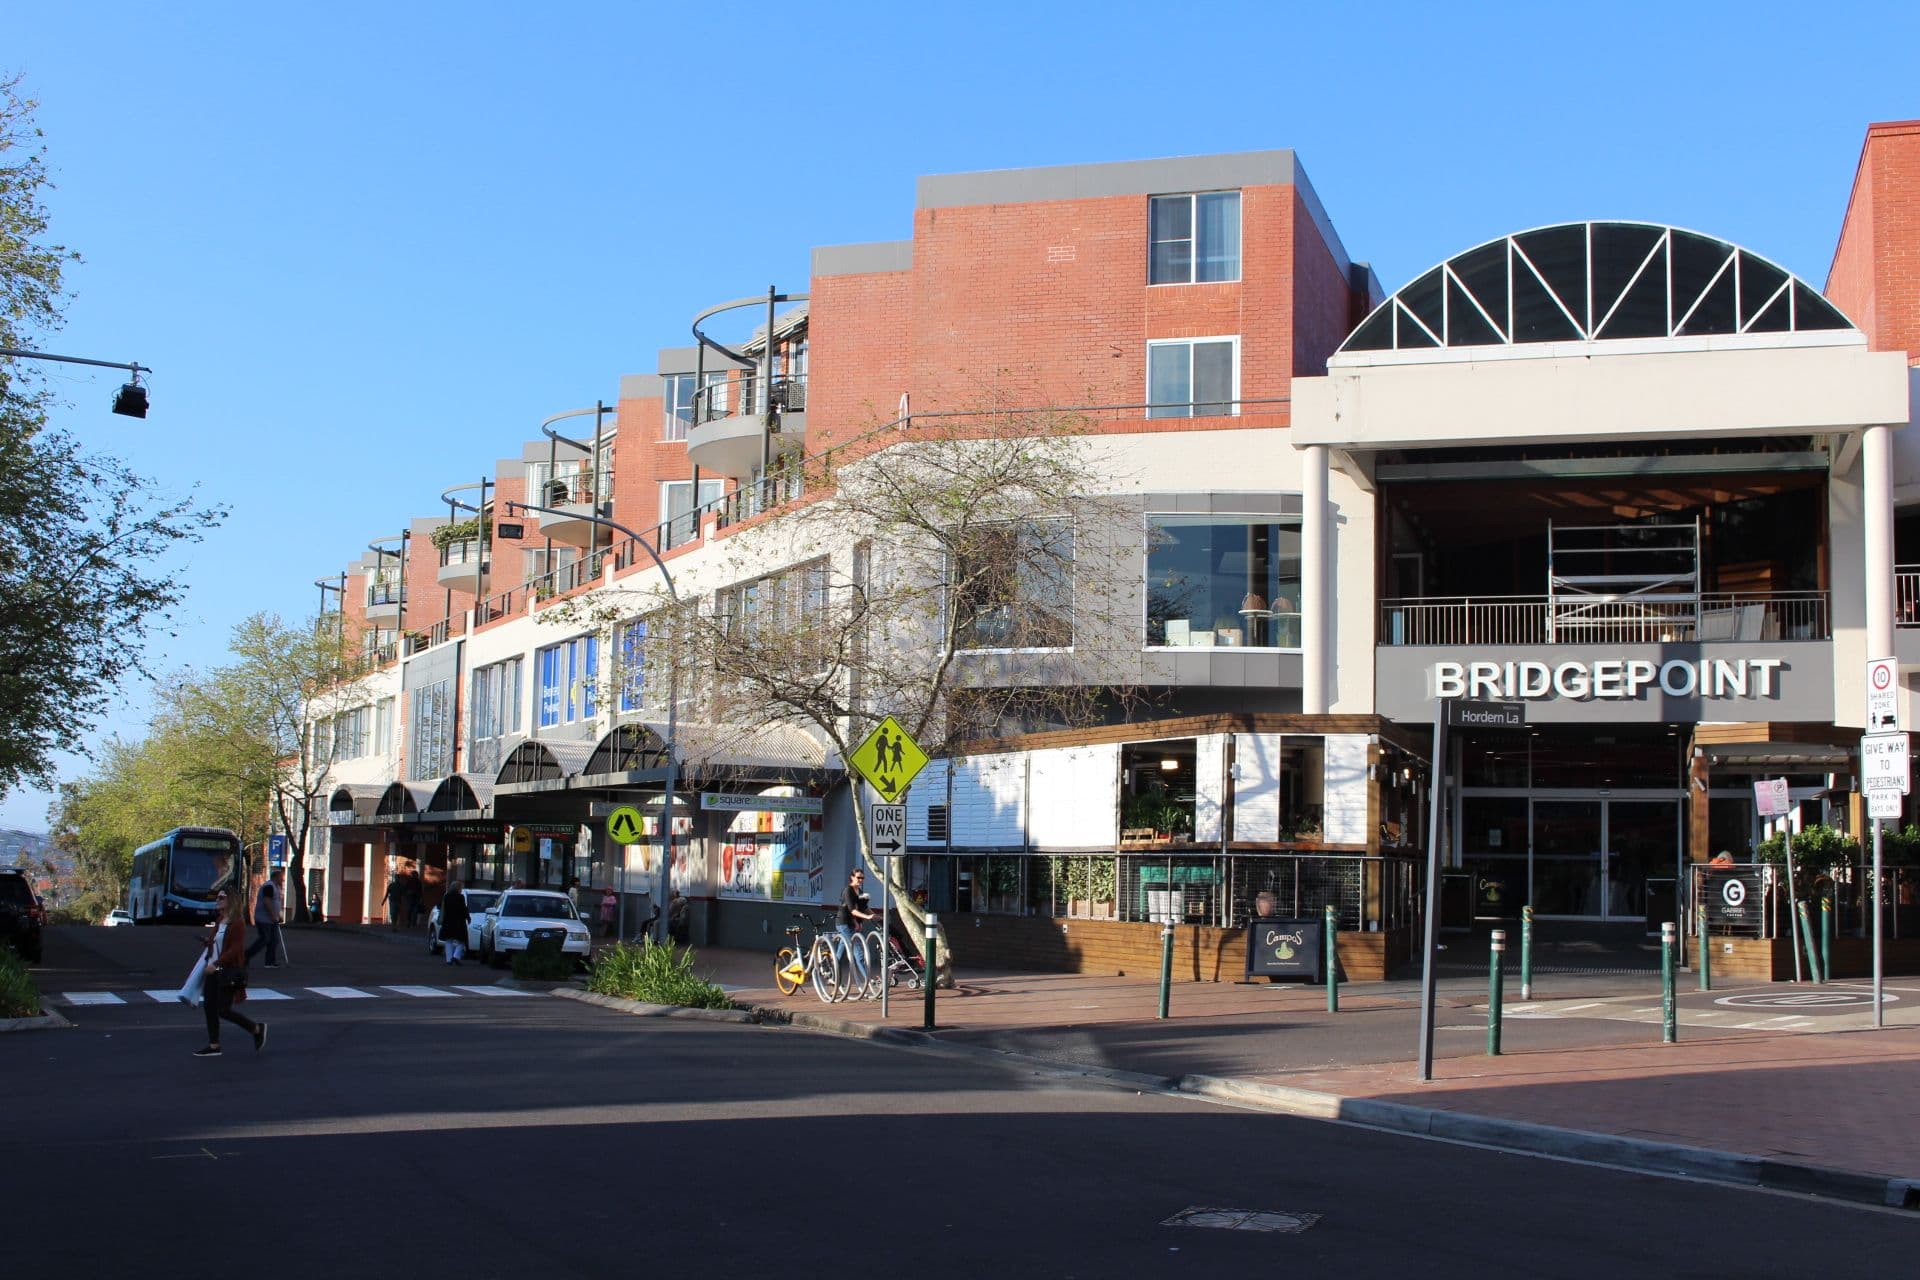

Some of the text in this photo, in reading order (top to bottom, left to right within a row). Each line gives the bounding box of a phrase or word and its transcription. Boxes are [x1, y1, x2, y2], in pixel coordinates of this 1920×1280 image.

[1434, 659, 1781, 698] BRIDGEPOINT
[1876, 671, 1887, 683] 10
[1870, 691, 1894, 701] SHARED
[1874, 701, 1891, 710] ZONE
[1506, 712, 1519, 724] La
[1864, 741, 1906, 755] GIVE WAY
[1880, 759, 1890, 770] TO
[1866, 775, 1905, 788] PEDESTRIANS
[1871, 792, 1898, 801] PARK IN
[876, 808, 903, 822] ONE
[875, 824, 903, 836] WAY
